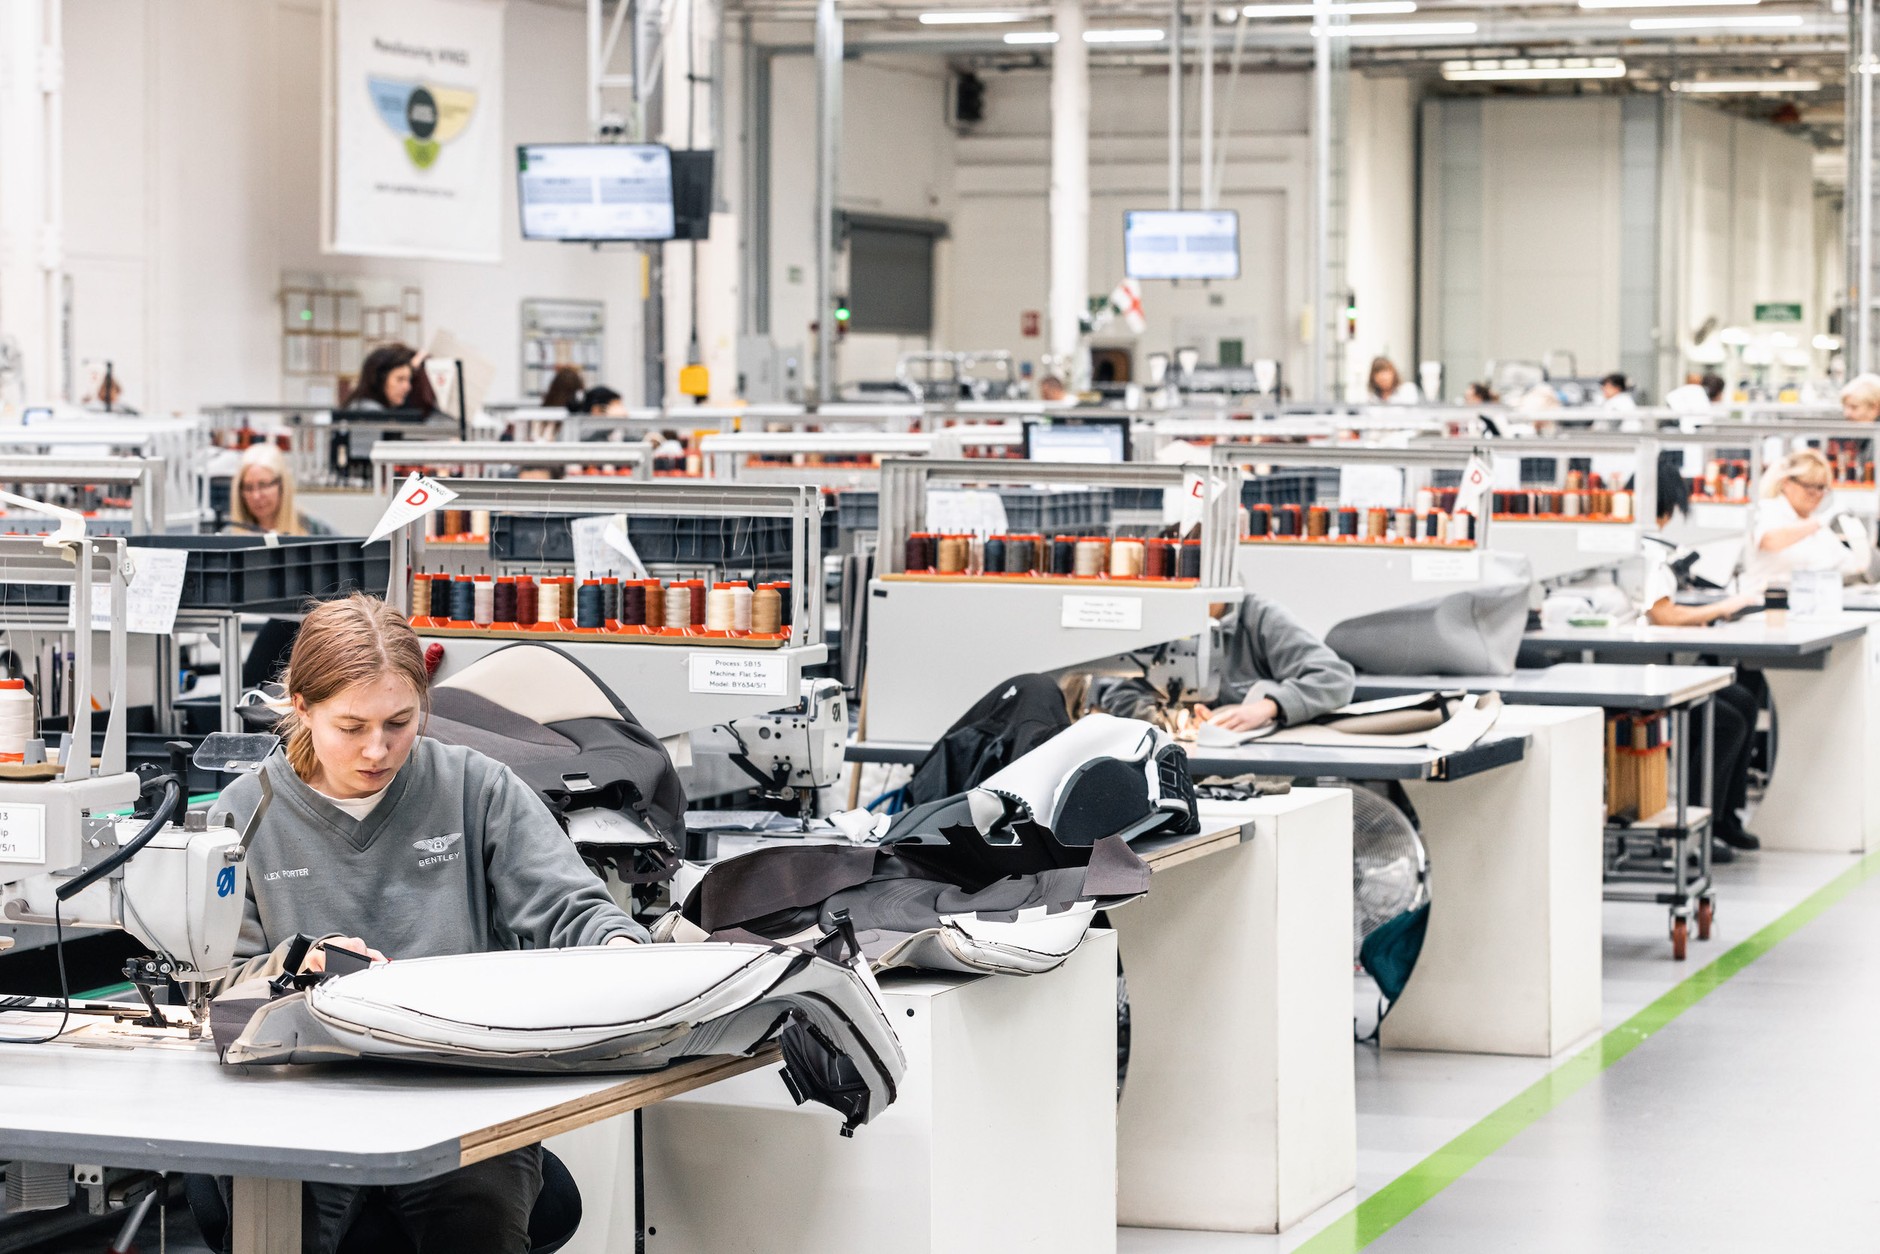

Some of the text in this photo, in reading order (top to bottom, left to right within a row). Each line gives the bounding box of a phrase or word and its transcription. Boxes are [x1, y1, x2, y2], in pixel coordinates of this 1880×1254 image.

[405, 488, 428, 506] D
[418, 851, 460, 867] BENTLEY
[282, 867, 309, 879] PORTER
